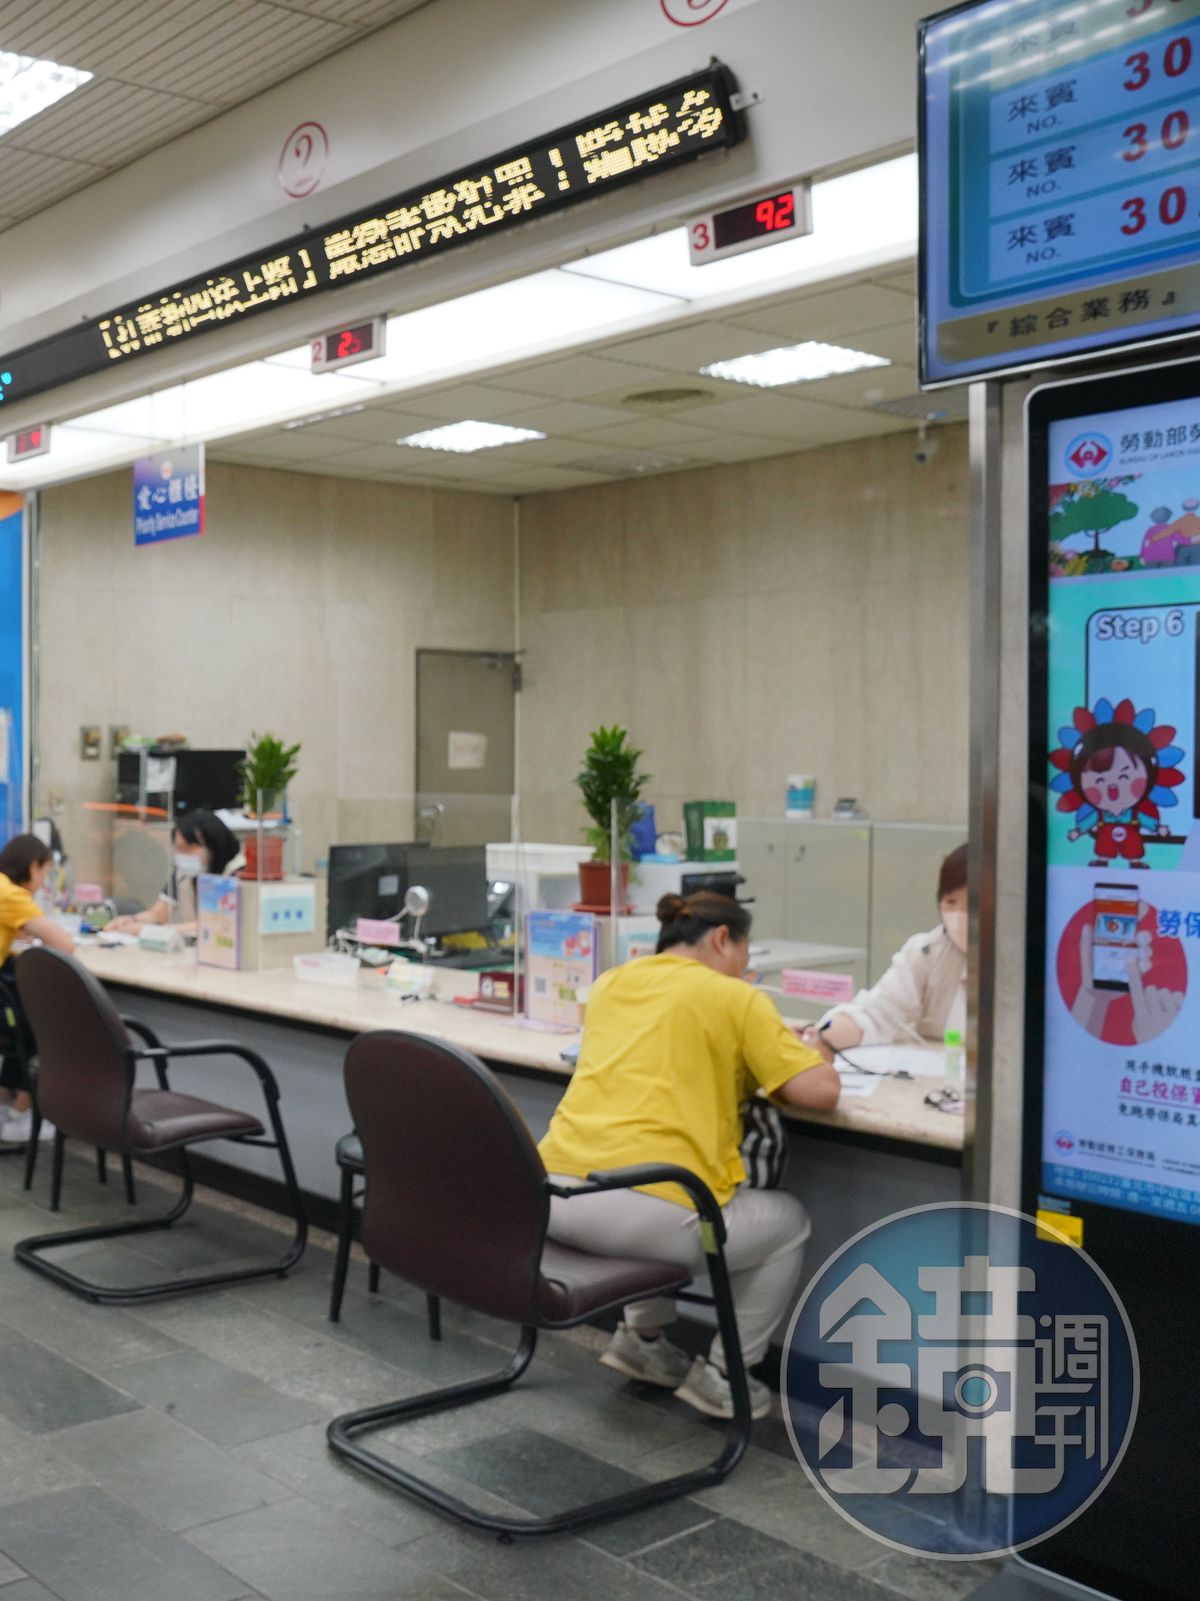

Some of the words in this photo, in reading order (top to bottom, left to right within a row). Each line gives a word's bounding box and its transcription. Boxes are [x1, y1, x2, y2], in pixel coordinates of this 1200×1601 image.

[756, 193, 794, 233] 92
[692, 223, 710, 250] 3
[1096, 613, 1159, 643] Step
[1165, 610, 1184, 636] 6
